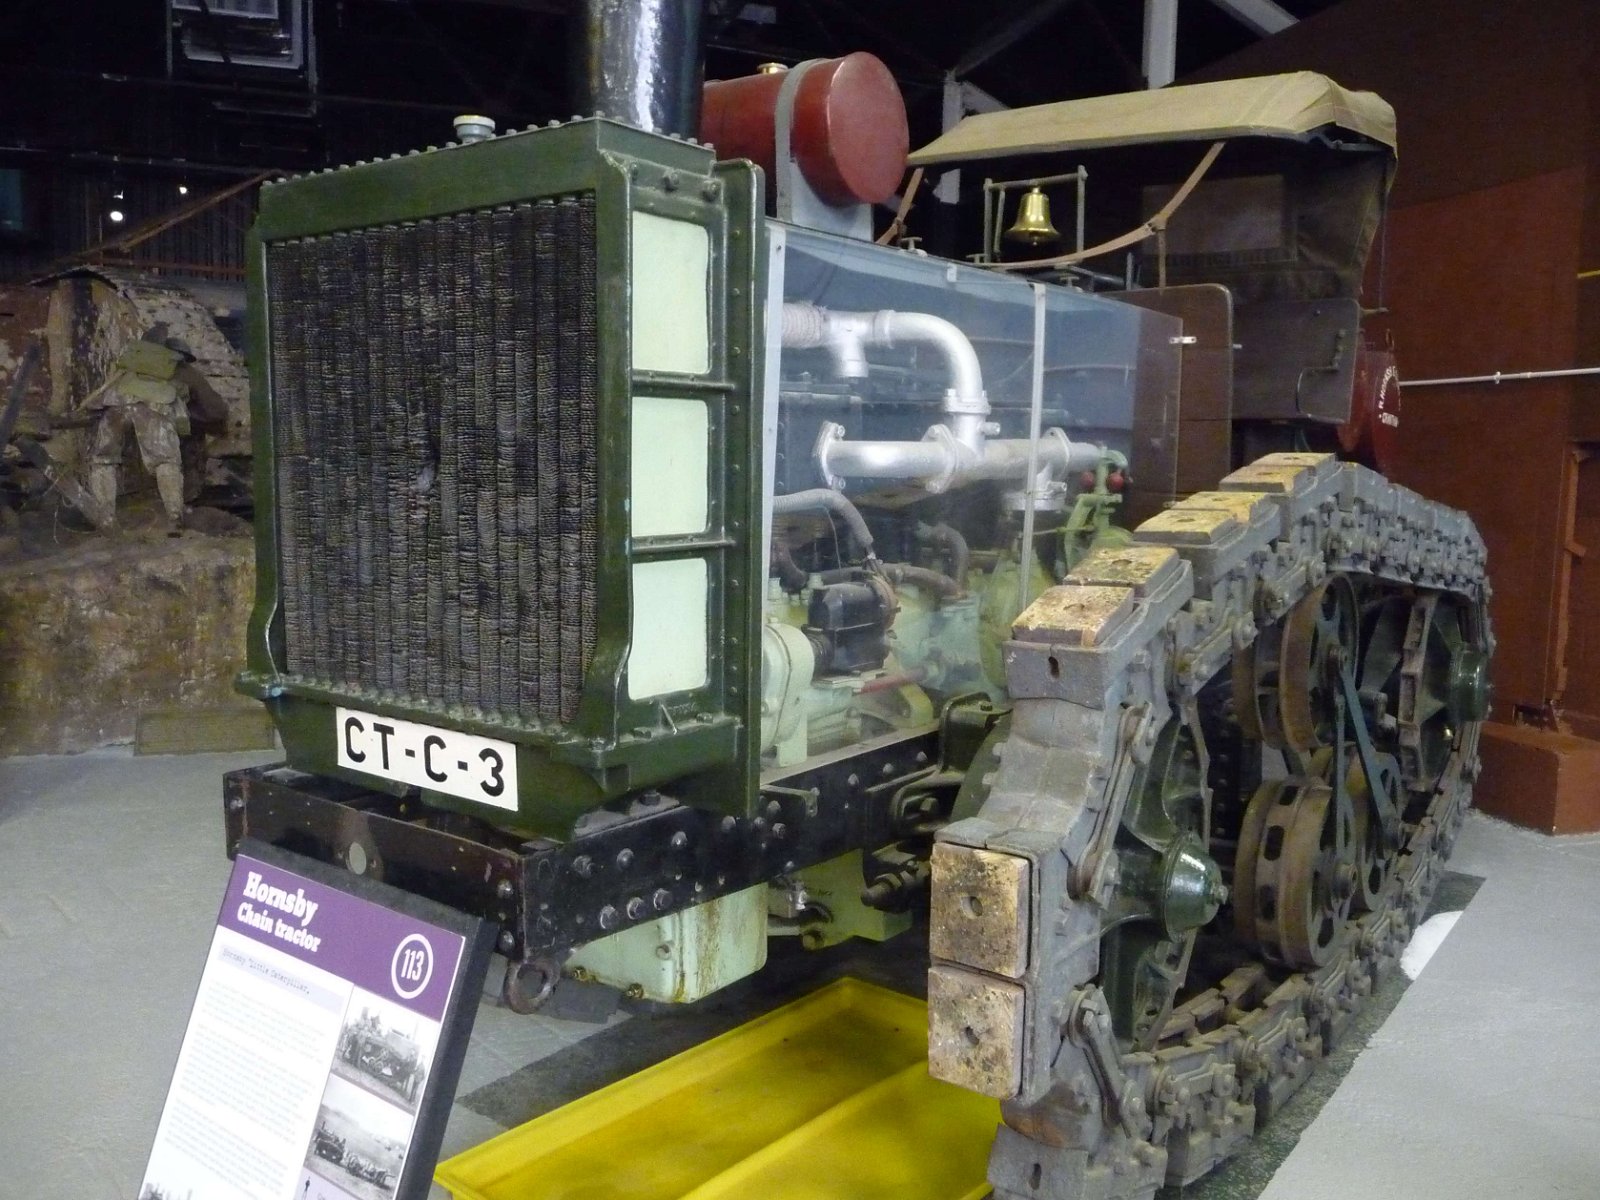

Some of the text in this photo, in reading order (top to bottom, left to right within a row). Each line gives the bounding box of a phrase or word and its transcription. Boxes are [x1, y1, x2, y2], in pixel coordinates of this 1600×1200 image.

[345, 717, 505, 797] CT-C-3
[243, 871, 319, 927] Hornsby
[237, 902, 322, 953] Chain tractor
[400, 949, 425, 981] 113
